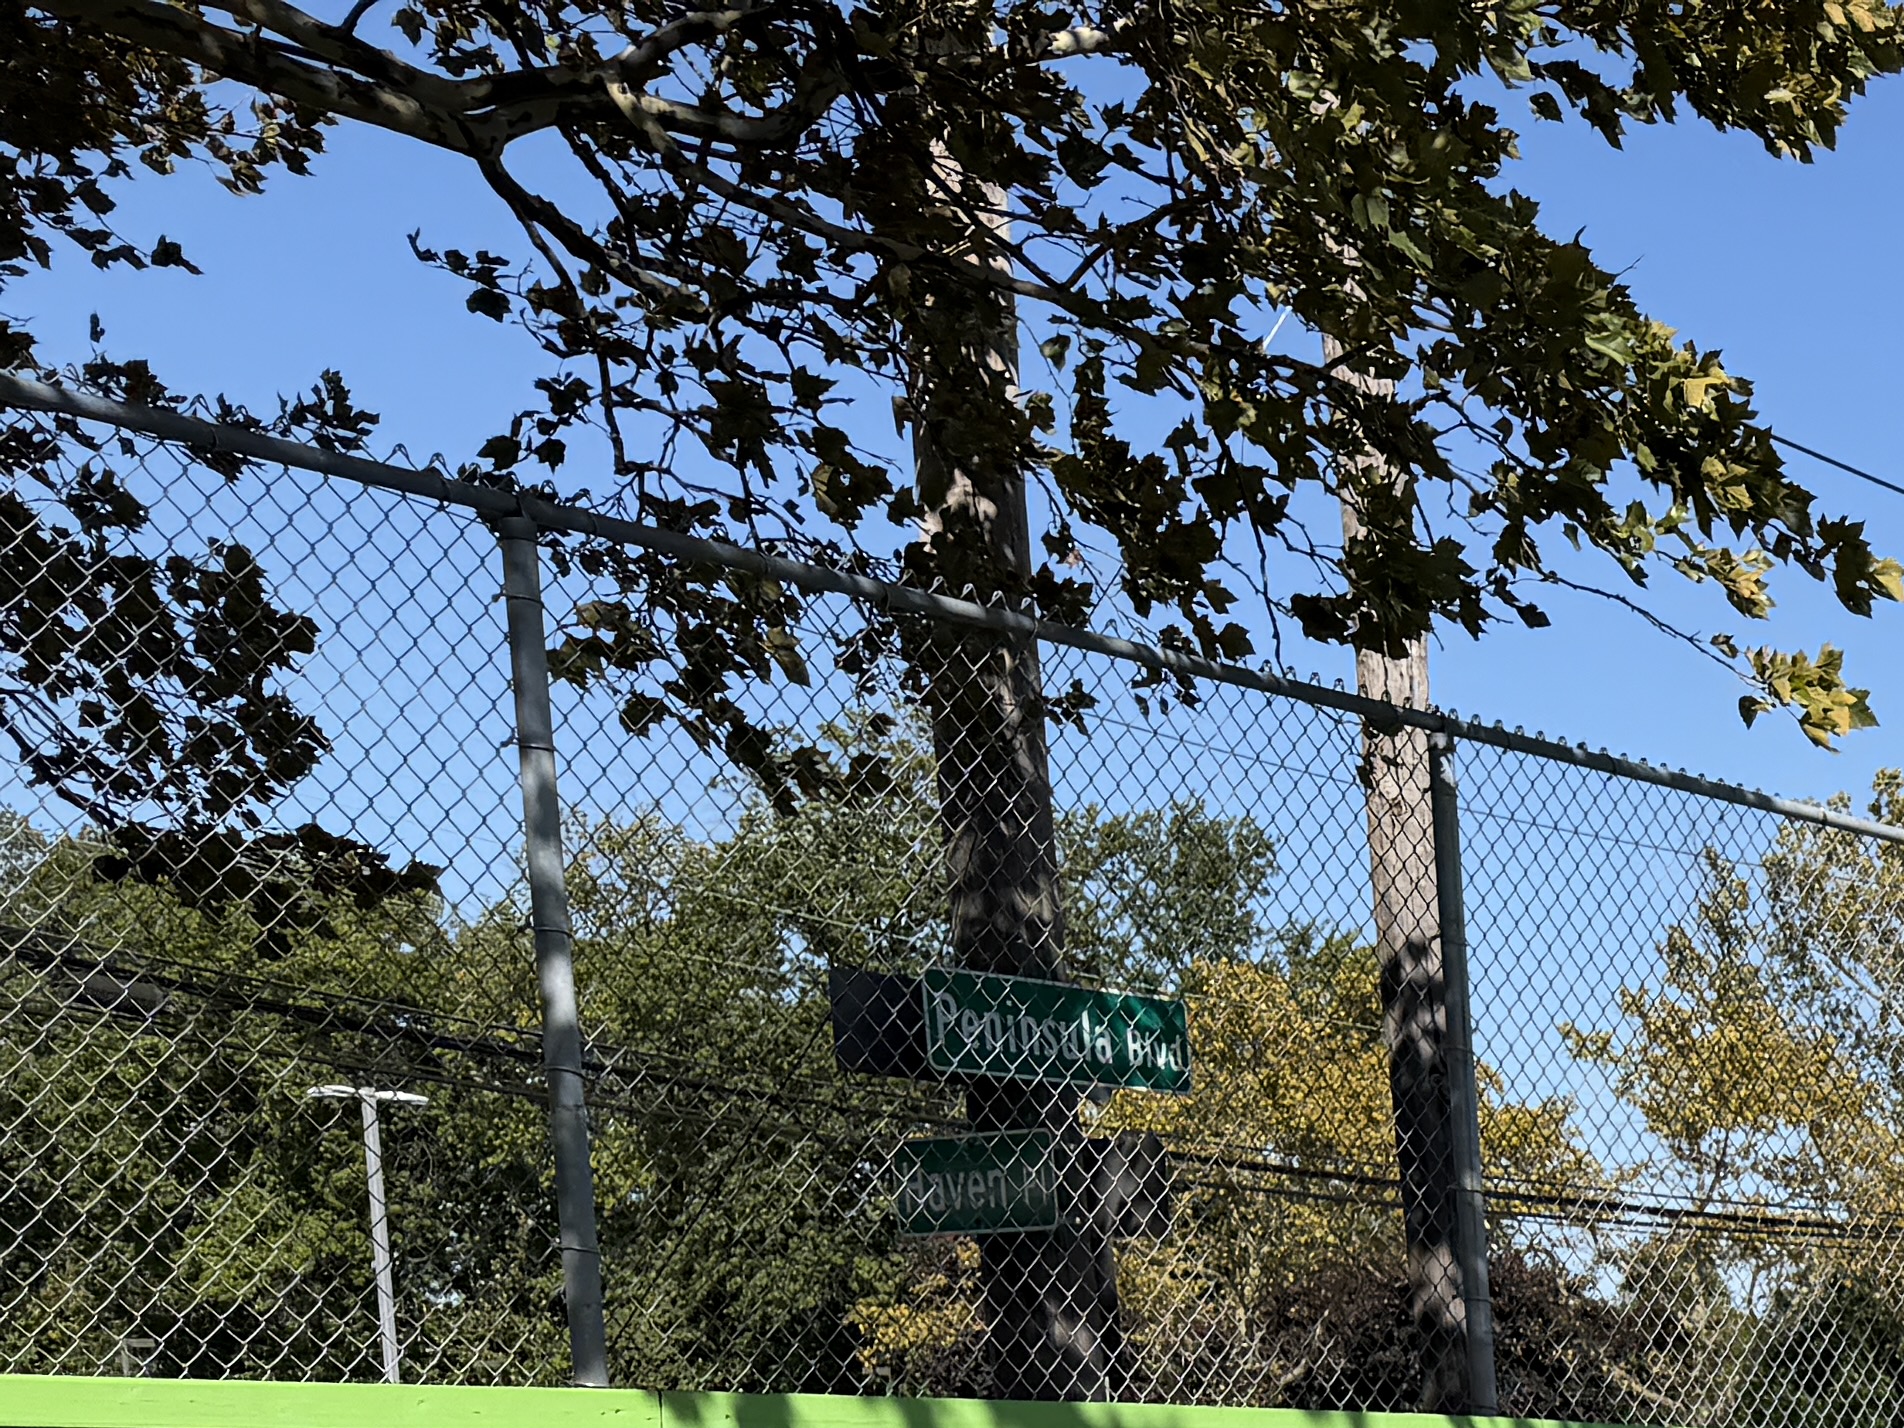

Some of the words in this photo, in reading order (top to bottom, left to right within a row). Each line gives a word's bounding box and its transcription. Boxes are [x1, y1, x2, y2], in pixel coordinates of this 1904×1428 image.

[935, 992, 1113, 1064] Peninsula
[1126, 1028, 1183, 1072] Blvd
[902, 1161, 1007, 1213] Haven
